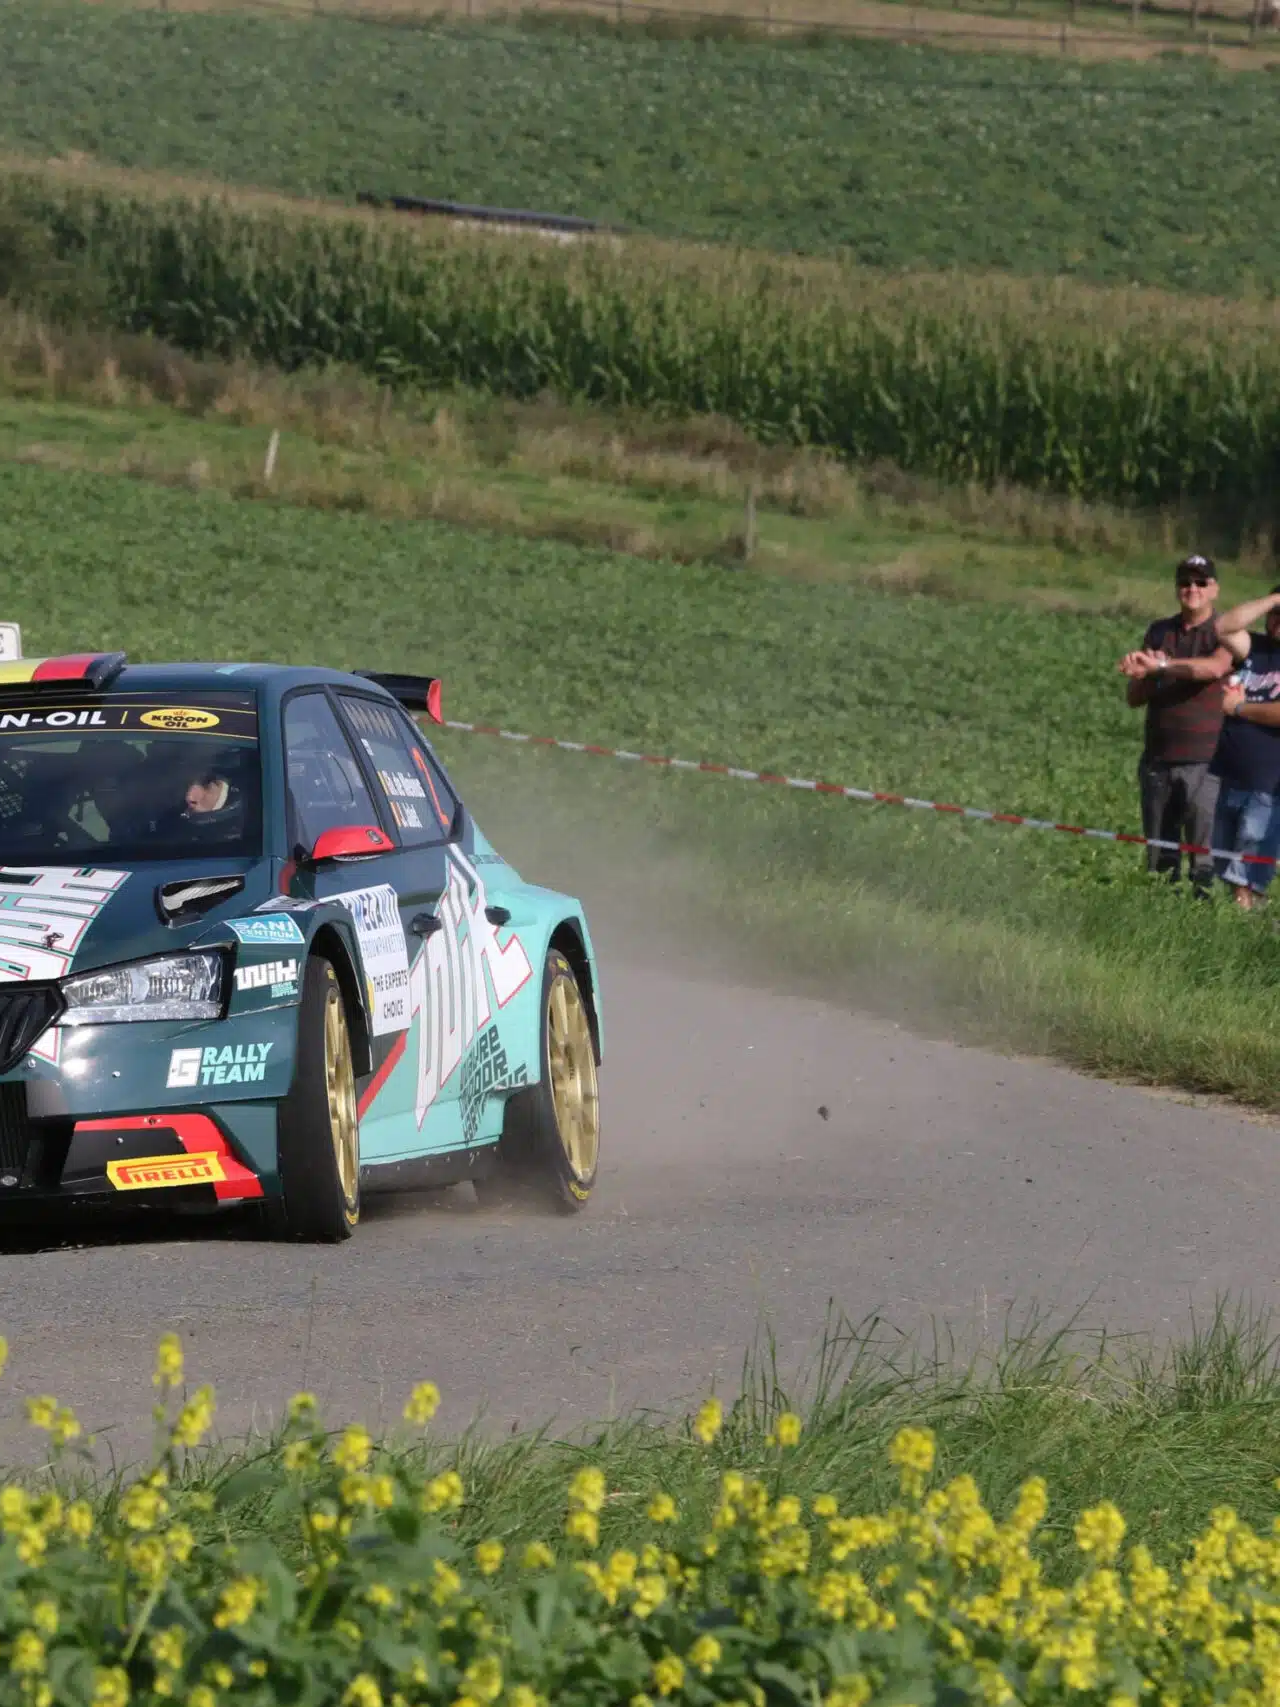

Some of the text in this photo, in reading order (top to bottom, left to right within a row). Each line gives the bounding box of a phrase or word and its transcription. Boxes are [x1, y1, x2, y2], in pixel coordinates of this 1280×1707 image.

[151, 714, 208, 723] KROON
[234, 920, 294, 932] SANI
[238, 929, 294, 939] CENTRUM
[373, 969, 408, 992] THE EXPERTS
[383, 999, 404, 1019] CHOICE
[202, 1042, 274, 1066] RALLY
[200, 1062, 266, 1086] TEAM
[116, 1157, 214, 1185] PIRELLI
